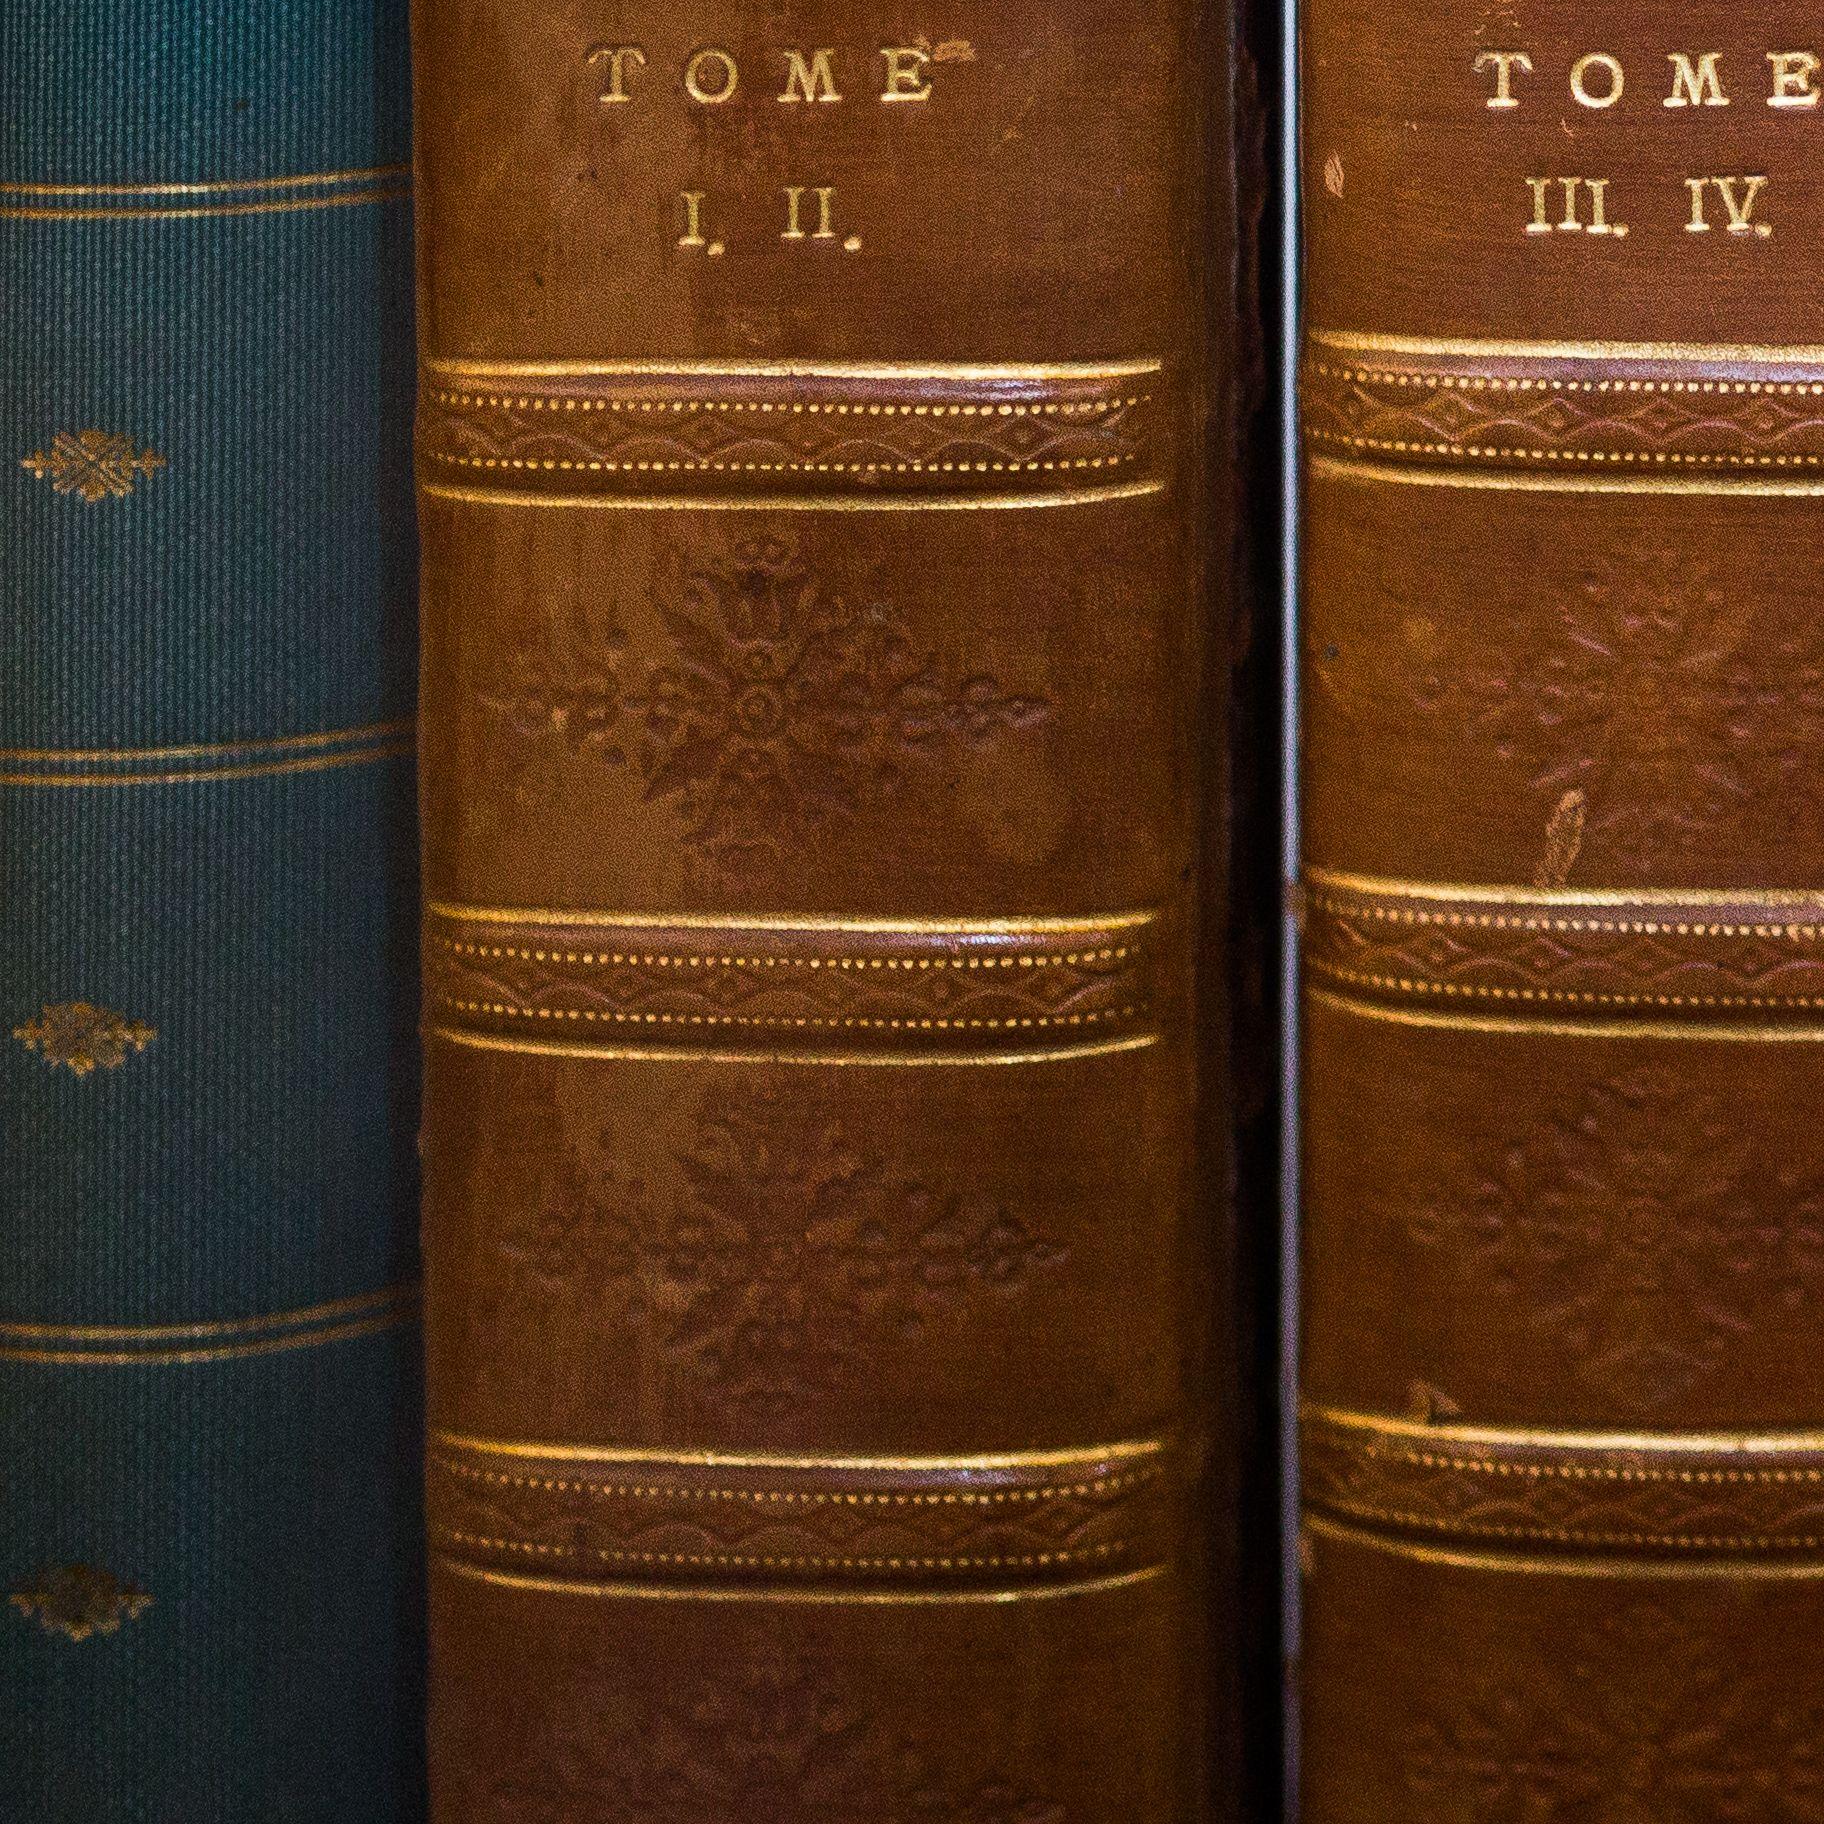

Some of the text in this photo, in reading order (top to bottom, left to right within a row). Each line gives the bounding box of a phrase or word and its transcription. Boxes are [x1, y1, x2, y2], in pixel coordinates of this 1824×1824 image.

[585, 46, 933, 105] TOME
[1471, 50, 1822, 109] TOME
[678, 187, 863, 256] I. II.
[1524, 175, 1771, 237] III. IV.
